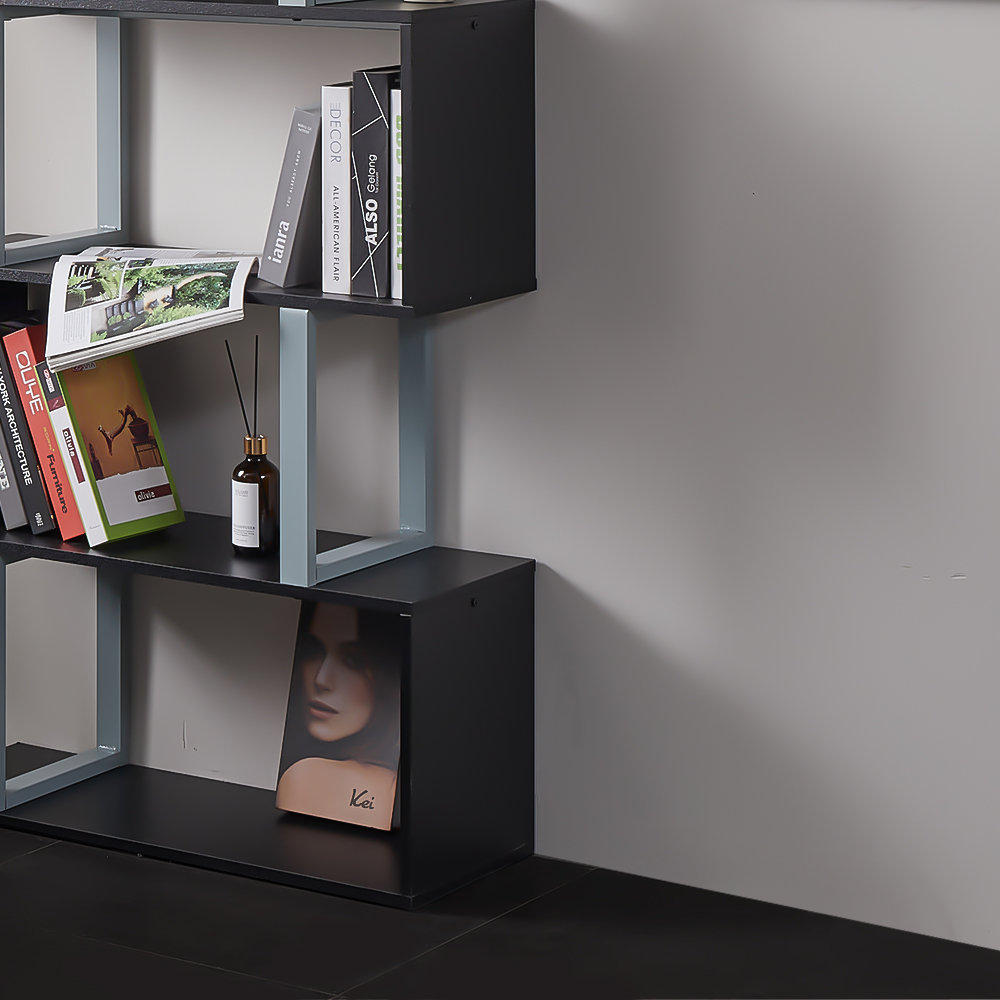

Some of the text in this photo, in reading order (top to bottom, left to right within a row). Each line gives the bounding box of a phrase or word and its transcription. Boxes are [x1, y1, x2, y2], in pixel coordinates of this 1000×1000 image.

[364, 153, 378, 246] ALSO Gelang
[267, 220, 290, 264] ianra
[4, 407, 33, 486] ARCHITECTURE
[46, 453, 68, 514] Furniture
[349, 788, 375, 809] Kei
